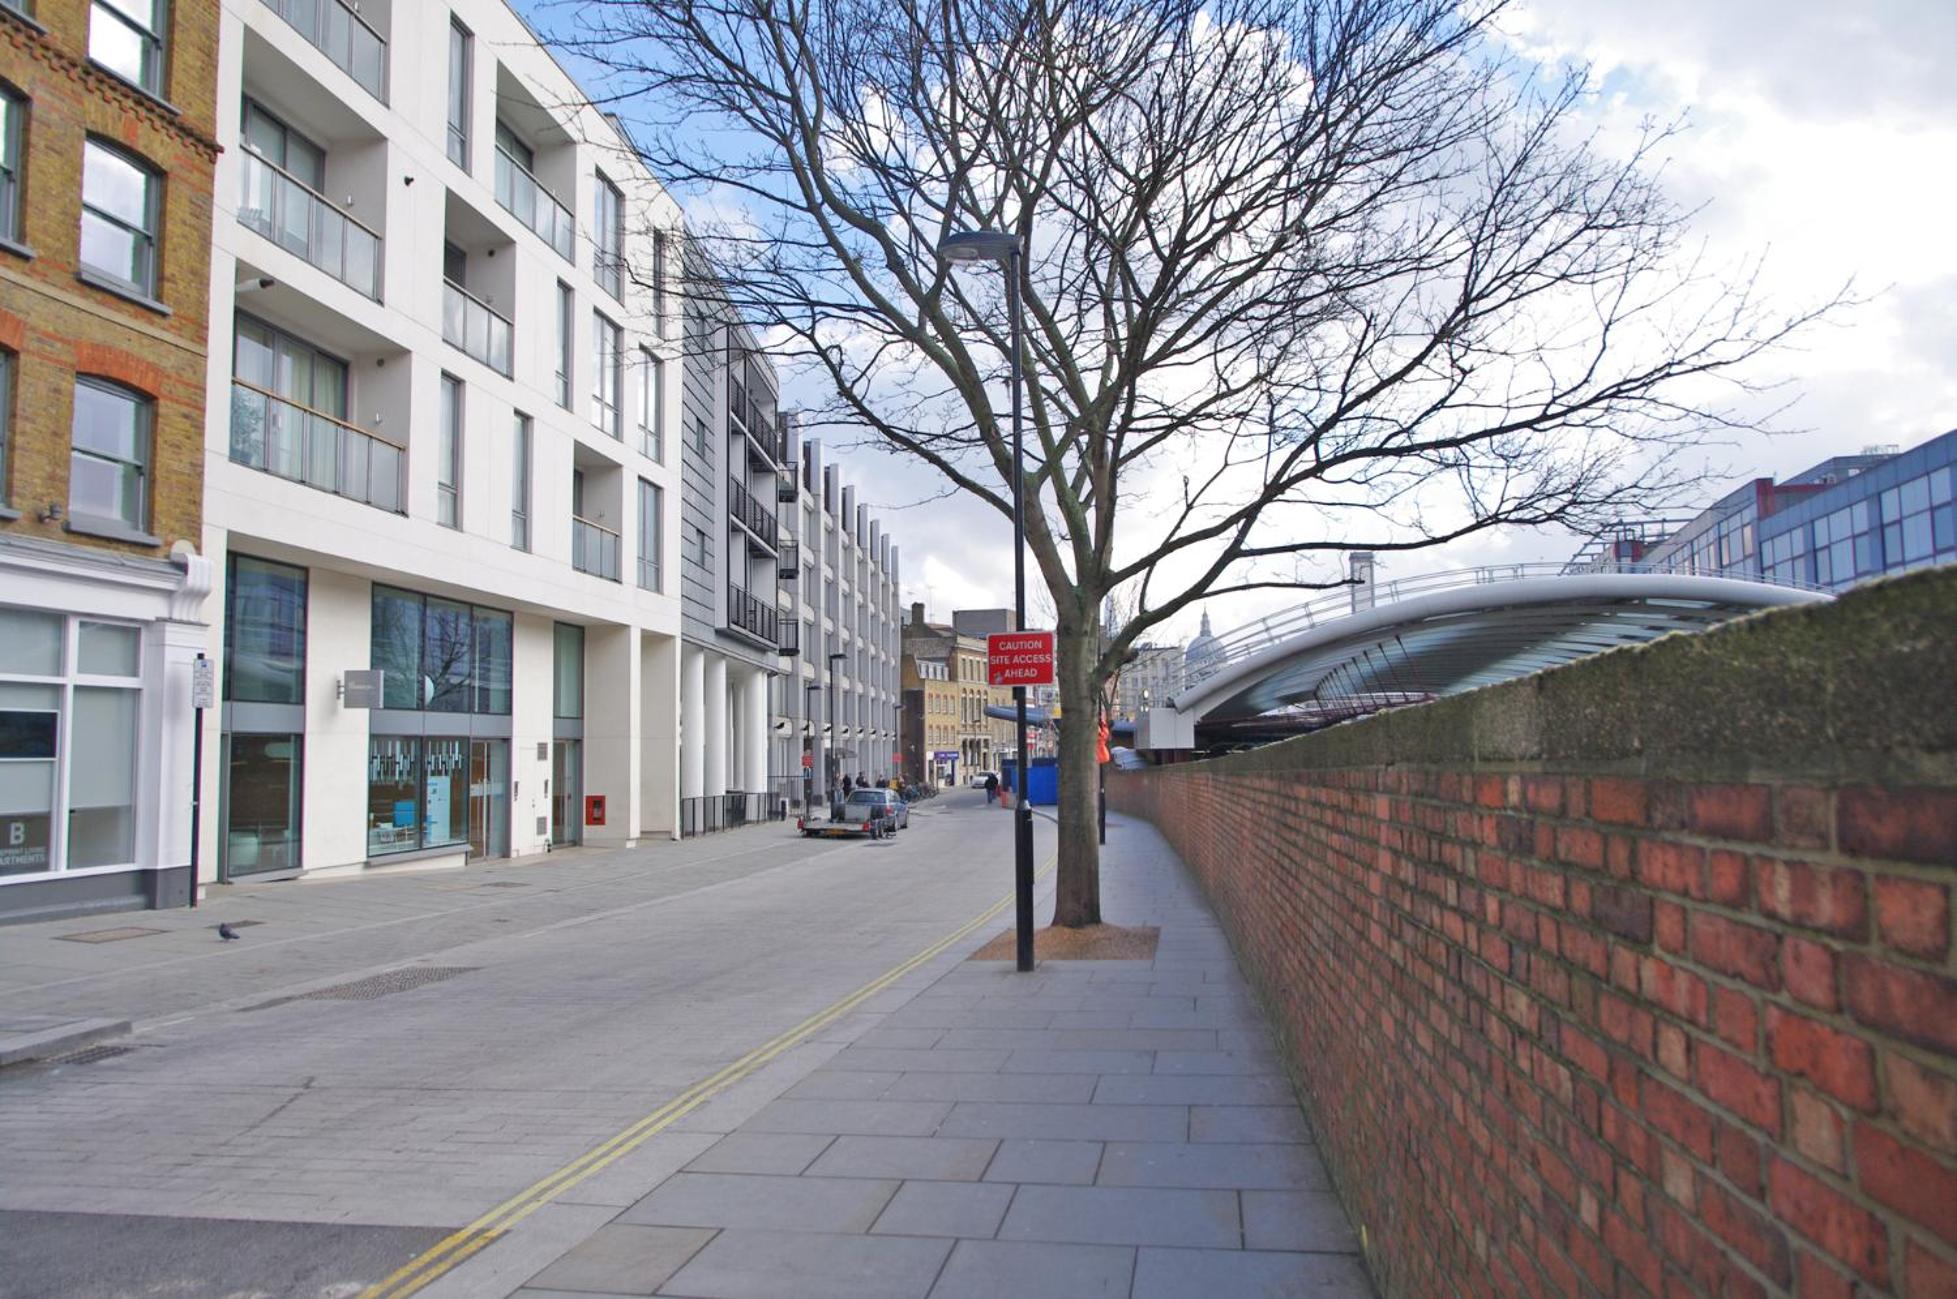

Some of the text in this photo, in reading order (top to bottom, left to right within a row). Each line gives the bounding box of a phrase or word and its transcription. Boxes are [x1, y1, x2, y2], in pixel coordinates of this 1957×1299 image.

[999, 640, 1042, 650] CAUTION
[990, 654, 1052, 664] SITE ACCESS
[1004, 669, 1037, 678] AHEAD
[9, 822, 25, 845] B
